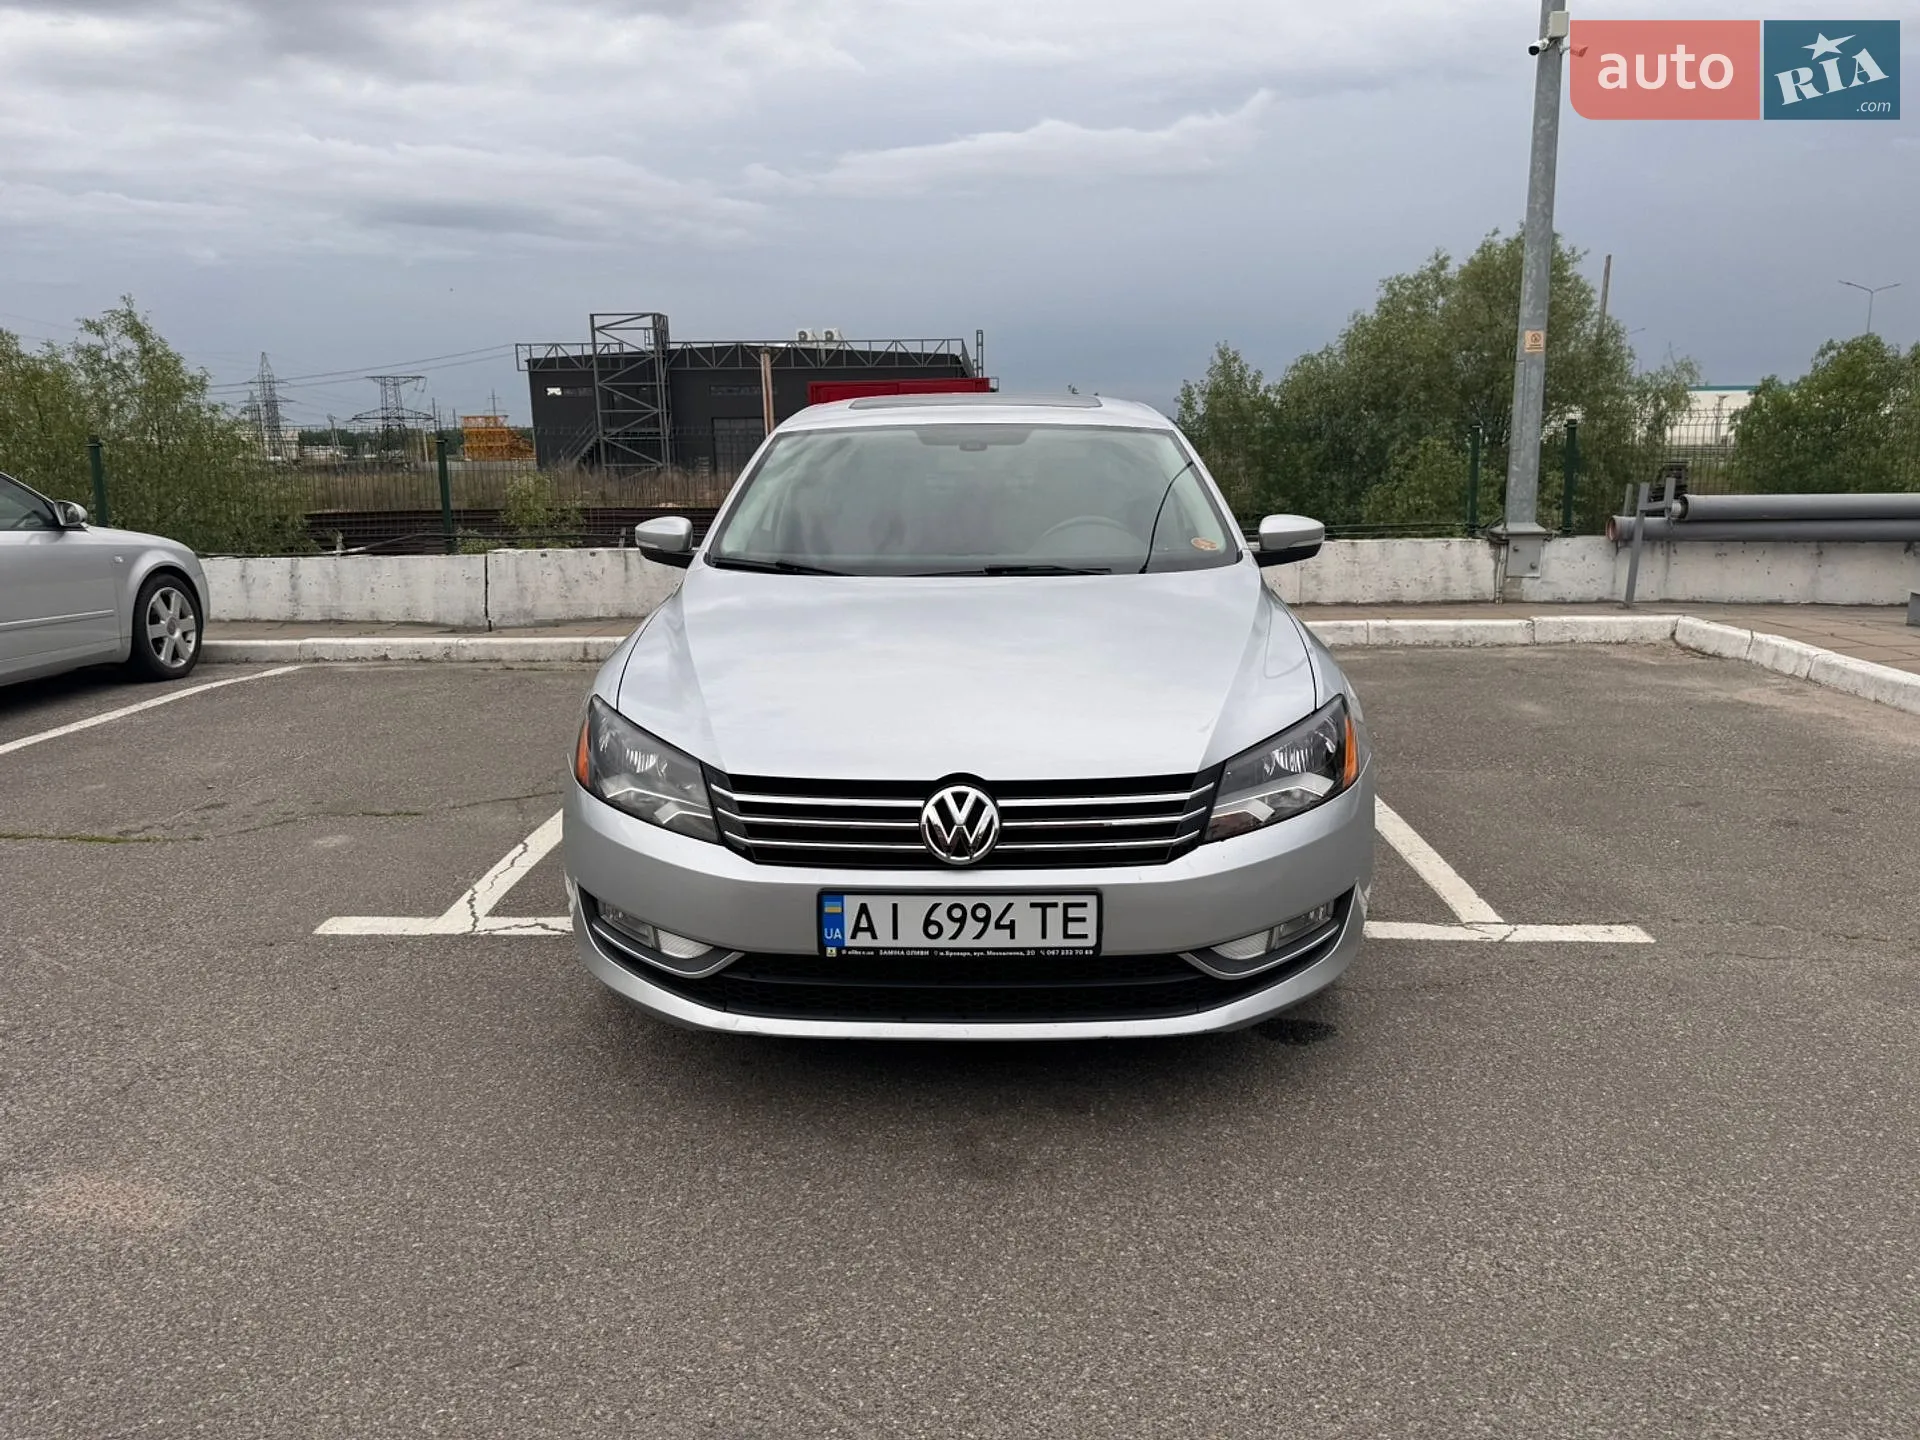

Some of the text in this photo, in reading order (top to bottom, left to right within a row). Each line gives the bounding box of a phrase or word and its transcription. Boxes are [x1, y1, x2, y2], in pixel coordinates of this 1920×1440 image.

[850, 902, 1089, 940] AI 6994 TE
[824, 928, 842, 940] UA
